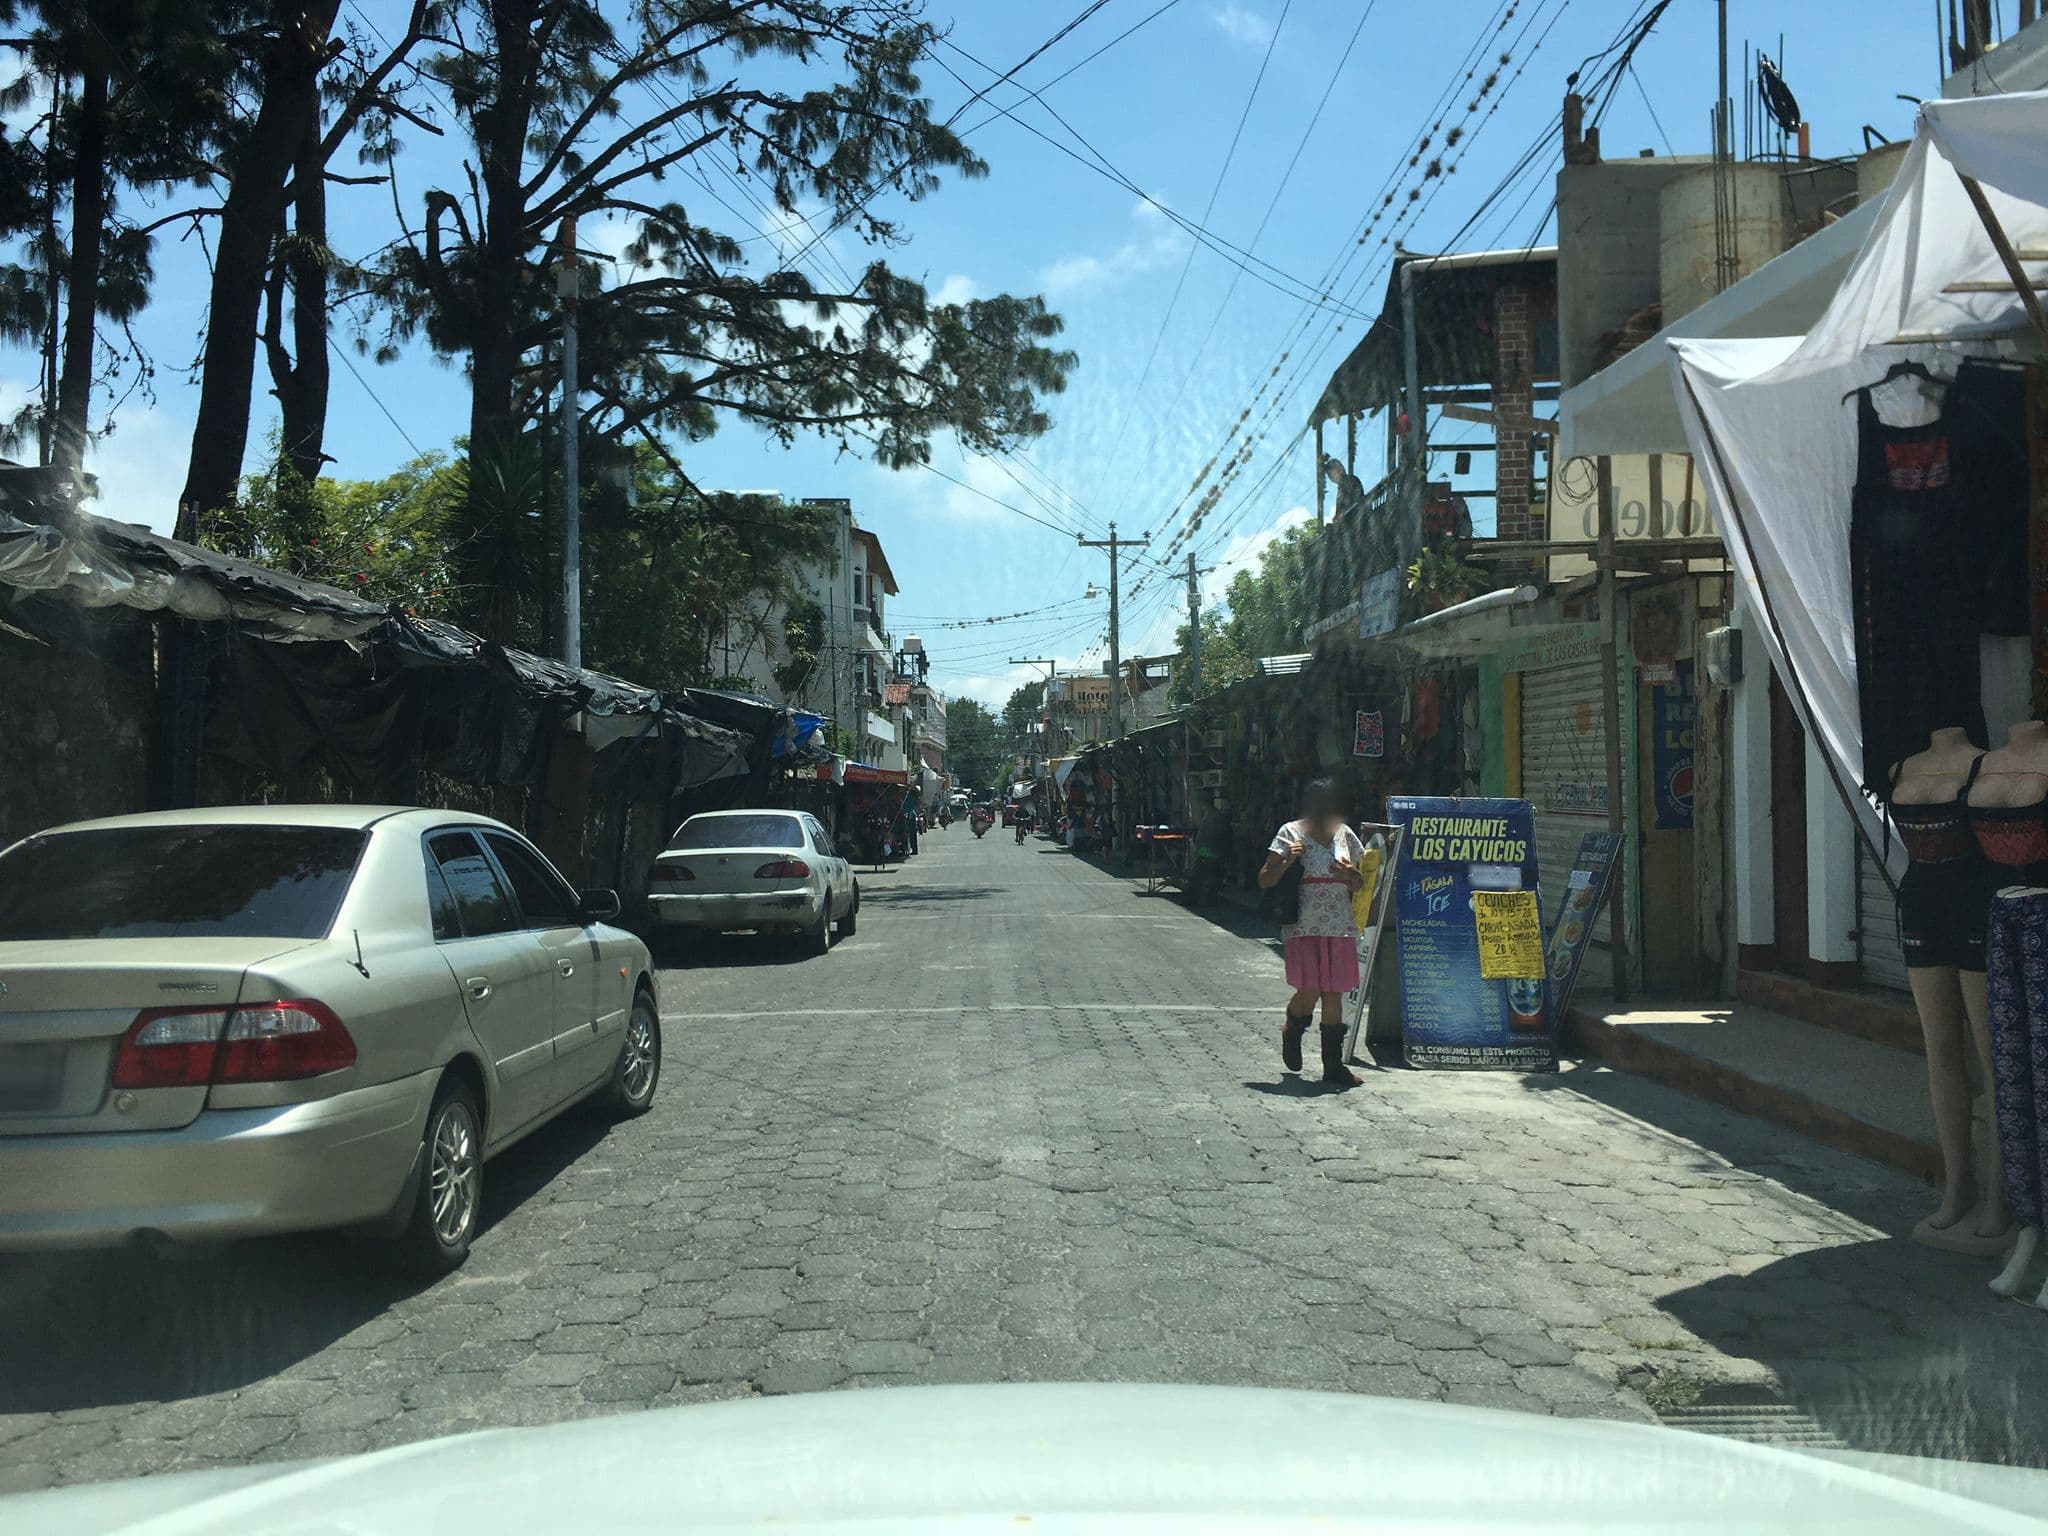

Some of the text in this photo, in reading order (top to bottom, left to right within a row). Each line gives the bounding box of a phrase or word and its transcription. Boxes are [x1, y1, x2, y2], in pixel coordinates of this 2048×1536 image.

[1411, 817, 1508, 837] RESTAURANTE
[1412, 838, 1527, 862] LOS CAYUCOS
[1478, 893, 1531, 908] CEVICHES
[1402, 919, 1447, 927] MICHELADAS
[1427, 1046, 1468, 1055] CONSUMO
[1470, 1047, 1482, 1055] DE
[1483, 1047, 1504, 1056] ESTE
[1505, 1047, 1550, 1057] PRODUCTO
[1411, 1054, 1440, 1063] CAUSA
[1441, 1055, 1471, 1064] SERIOS
[1472, 1055, 1501, 1065] DAÑOS
[1509, 1056, 1520, 1066] LA
